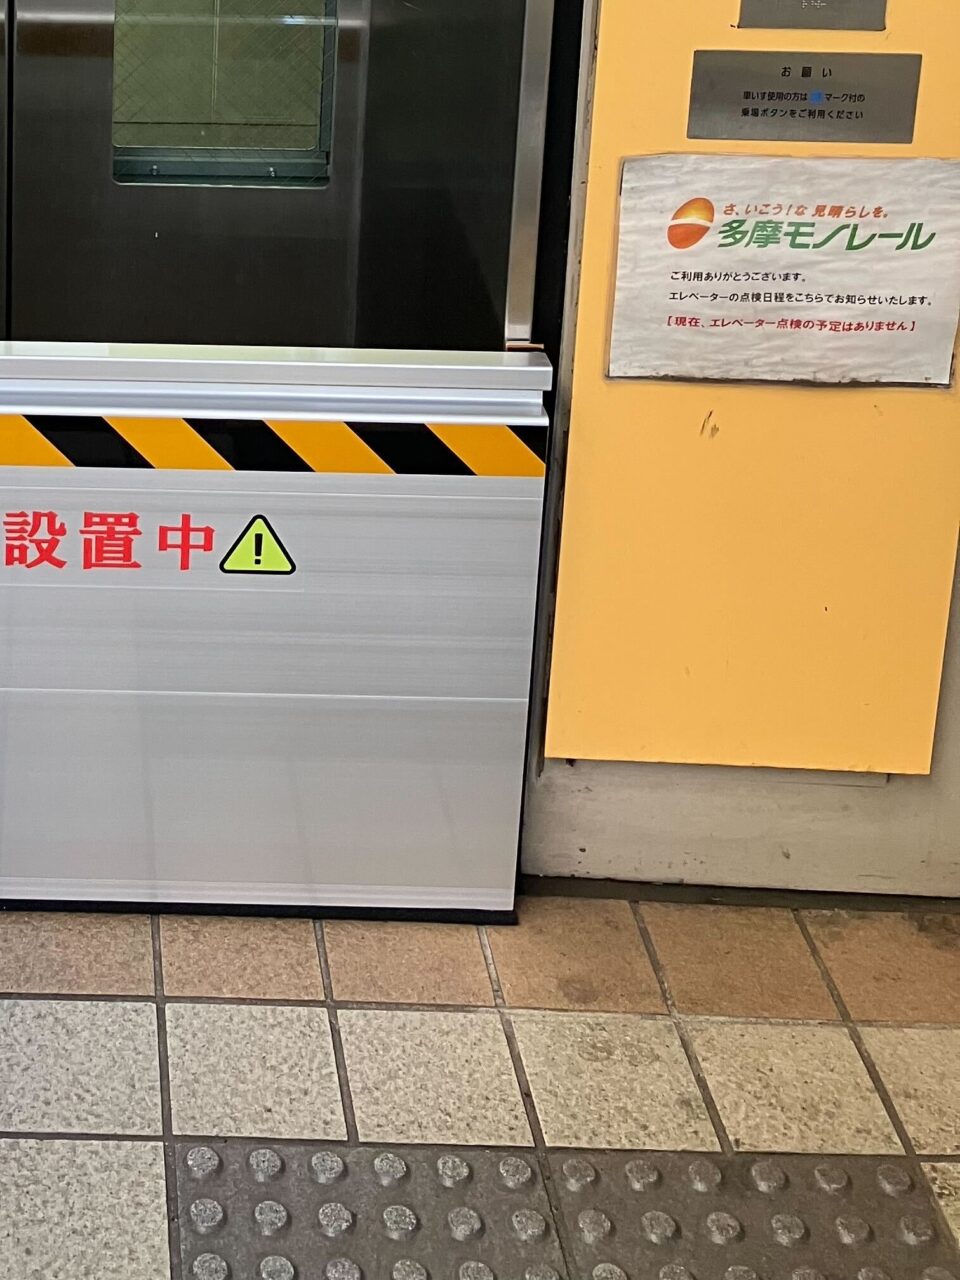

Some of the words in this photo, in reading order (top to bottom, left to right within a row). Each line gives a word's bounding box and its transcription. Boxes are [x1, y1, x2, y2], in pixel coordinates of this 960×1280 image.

[717, 219, 937, 251] 多摩モノレール
[670, 271, 807, 283] ご利用ありがとうございます。
[668, 291, 933, 307] エレベーターの点検日程をこちらでお知らせいたします。
